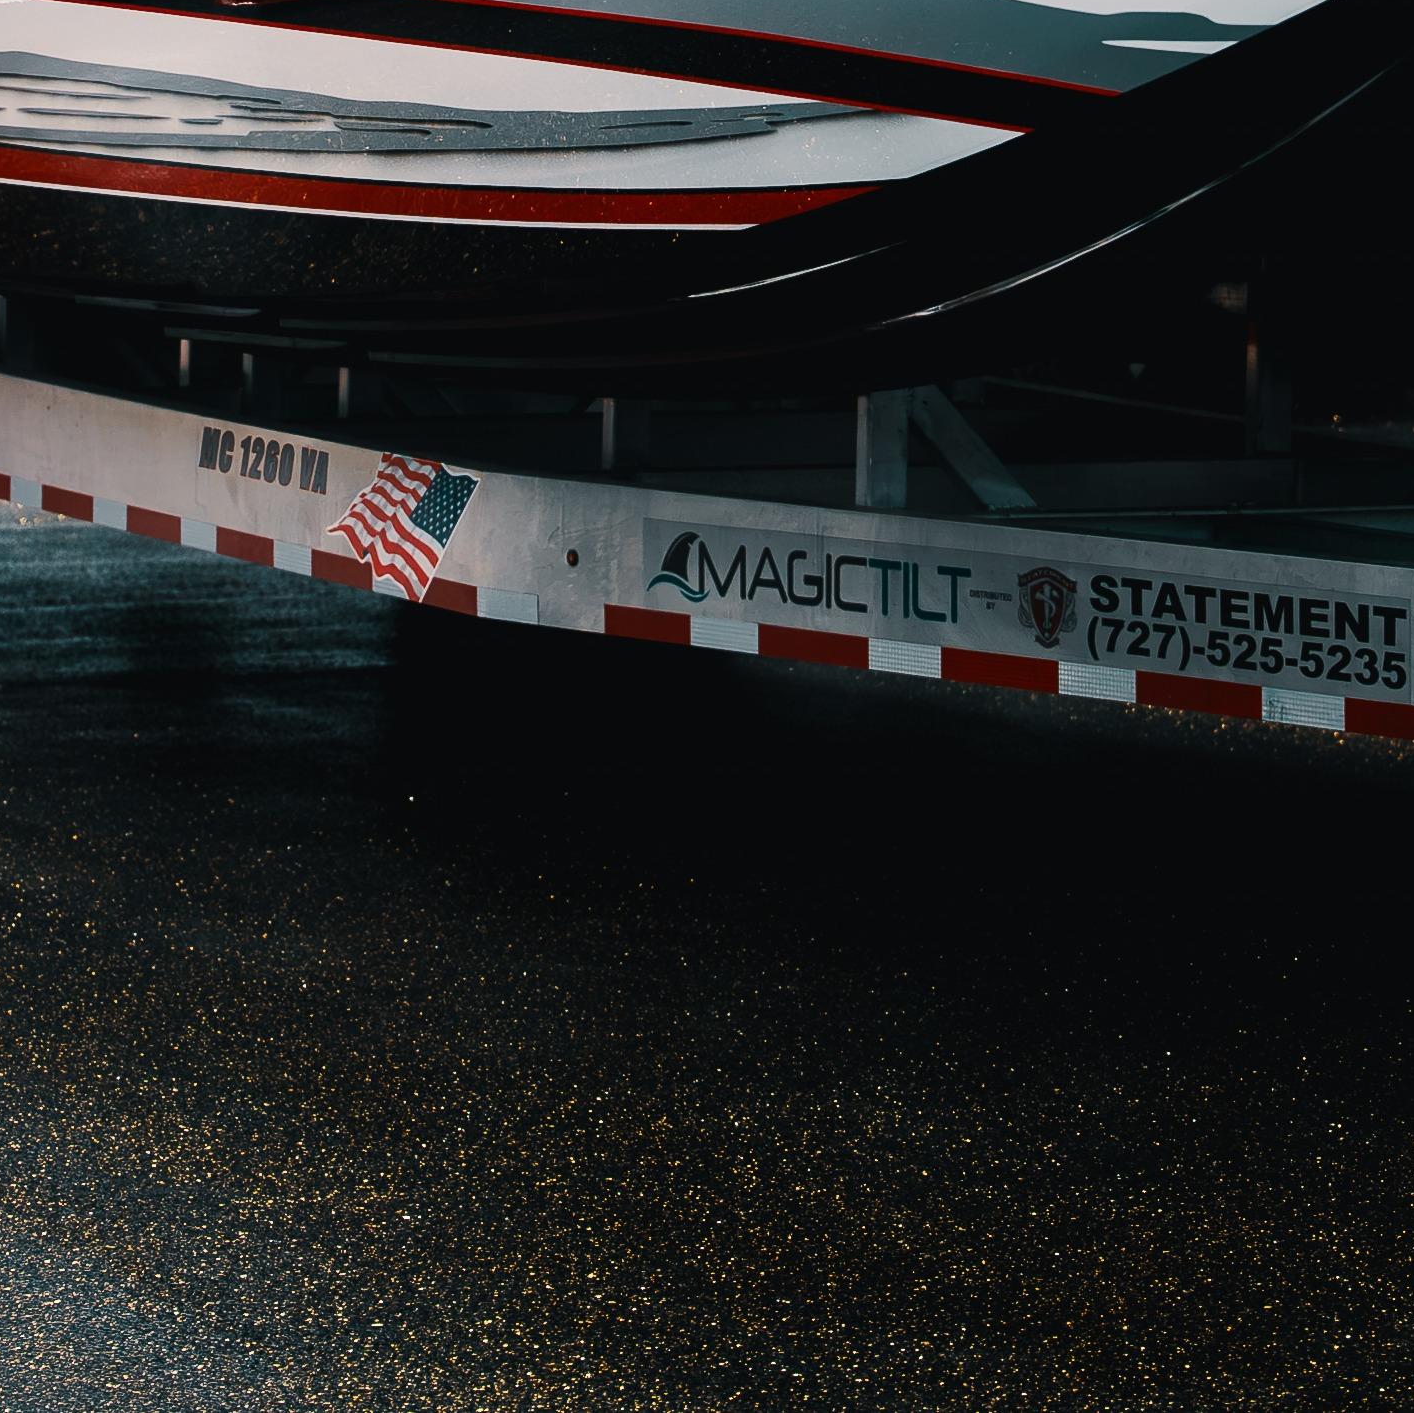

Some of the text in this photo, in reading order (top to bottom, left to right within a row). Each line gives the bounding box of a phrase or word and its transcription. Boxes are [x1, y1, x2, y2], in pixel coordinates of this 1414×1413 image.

[198, 426, 330, 495] MC 1260 VA
[697, 539, 972, 624] MAGICTILT
[1089, 574, 1408, 647] STATEMENT
[1087, 615, 1408, 690] (727)-525-5235
